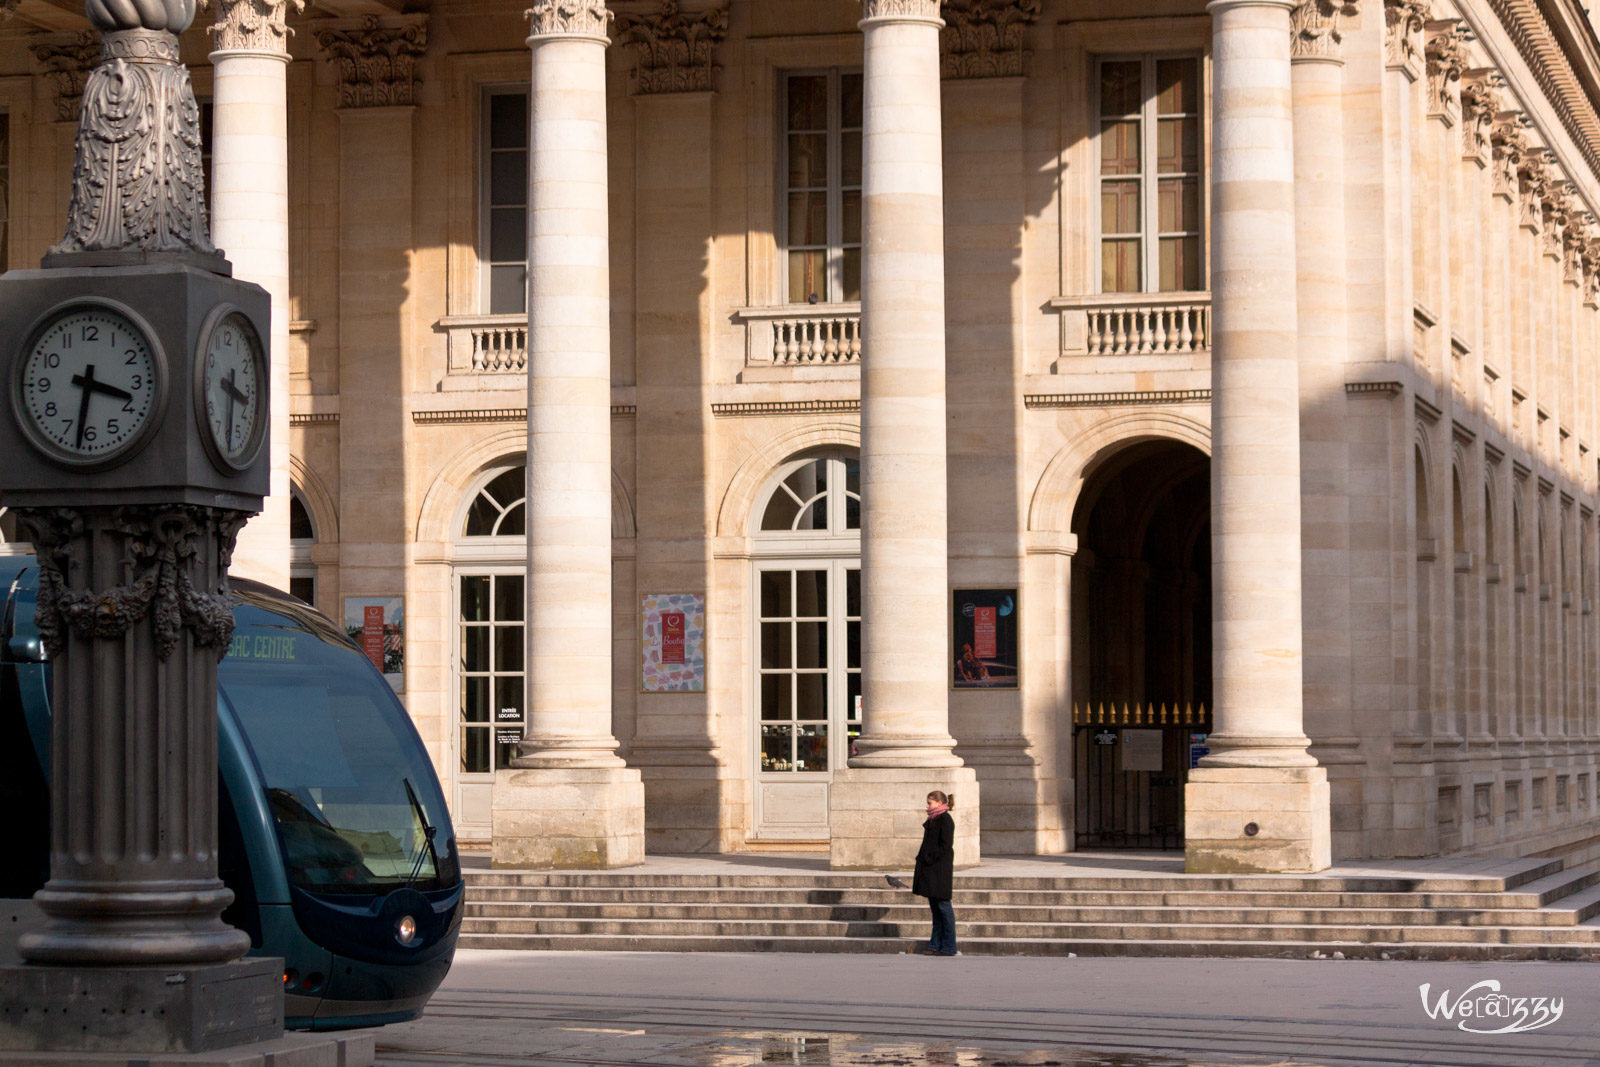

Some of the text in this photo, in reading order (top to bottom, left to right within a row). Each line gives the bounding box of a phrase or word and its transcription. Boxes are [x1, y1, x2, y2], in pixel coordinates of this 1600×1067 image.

[63, 333, 72, 348] 11
[82, 326, 99, 341] 12
[111, 332, 115, 347] 1
[223, 331, 232, 346] 12
[44, 353, 60, 368] 10
[124, 350, 137, 365] 2
[242, 359, 249, 374] 2
[38, 377, 50, 392] 9
[131, 375, 142, 390] 3
[44, 402, 58, 416] 8
[121, 399, 135, 414] 4
[61, 419, 74, 435] 7
[84, 426, 97, 441] 6
[107, 419, 119, 434] 5
[215, 420, 222, 435] 7
[234, 424, 241, 439] 5
[254, 635, 297, 660] CENTRE
